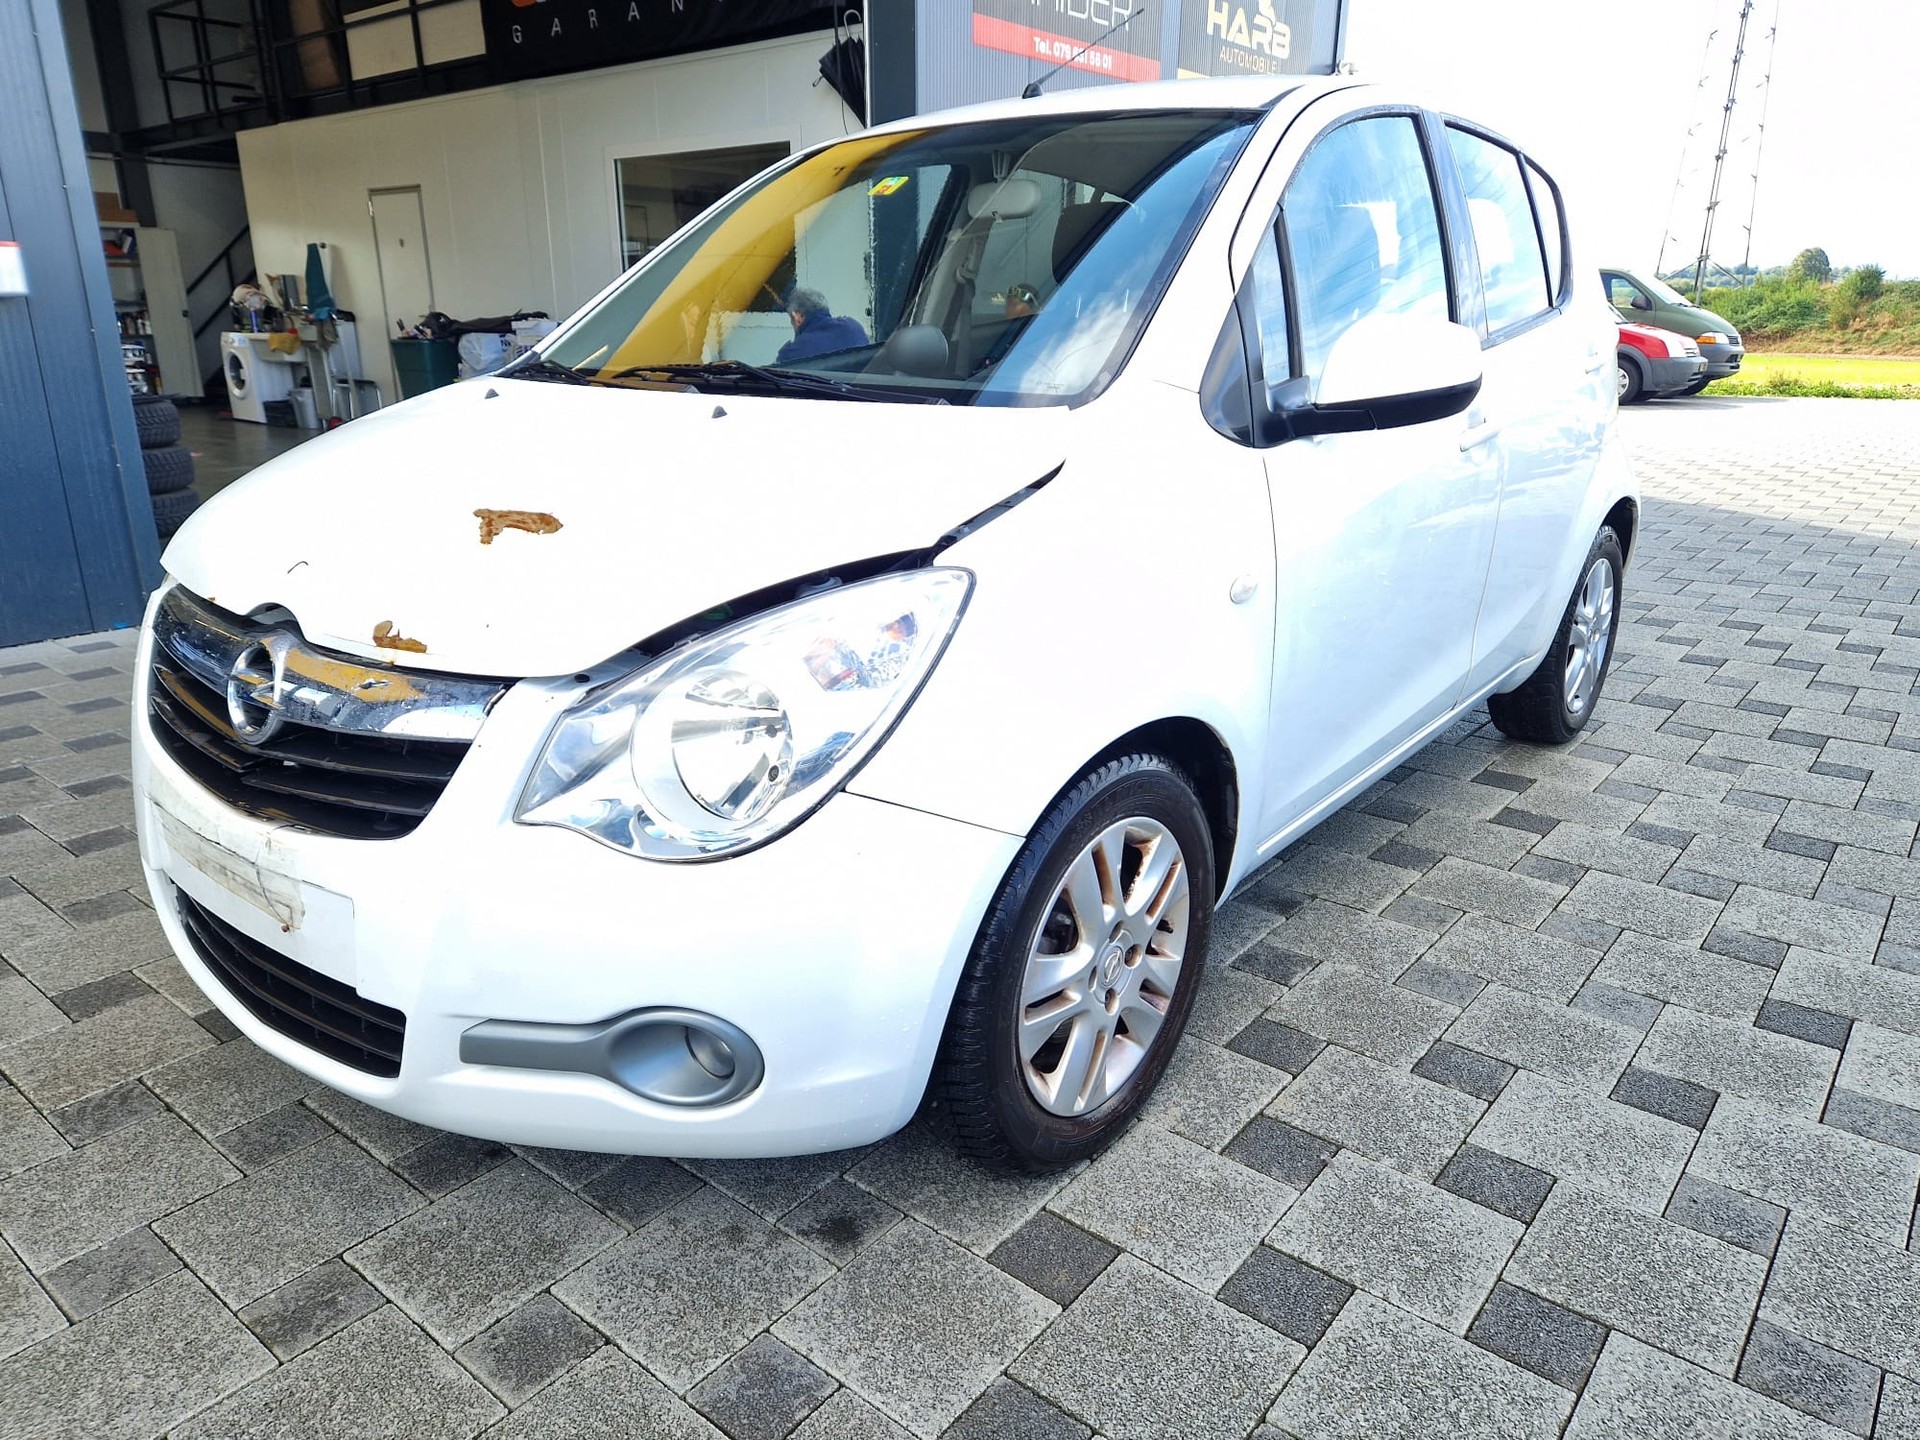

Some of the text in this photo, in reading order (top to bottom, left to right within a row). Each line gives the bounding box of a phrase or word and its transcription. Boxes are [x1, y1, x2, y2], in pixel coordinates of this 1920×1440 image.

[1033, 36, 1052, 56] Tel.
[1053, 41, 1071, 61] 079
[1206, 0, 1291, 59] HARB
